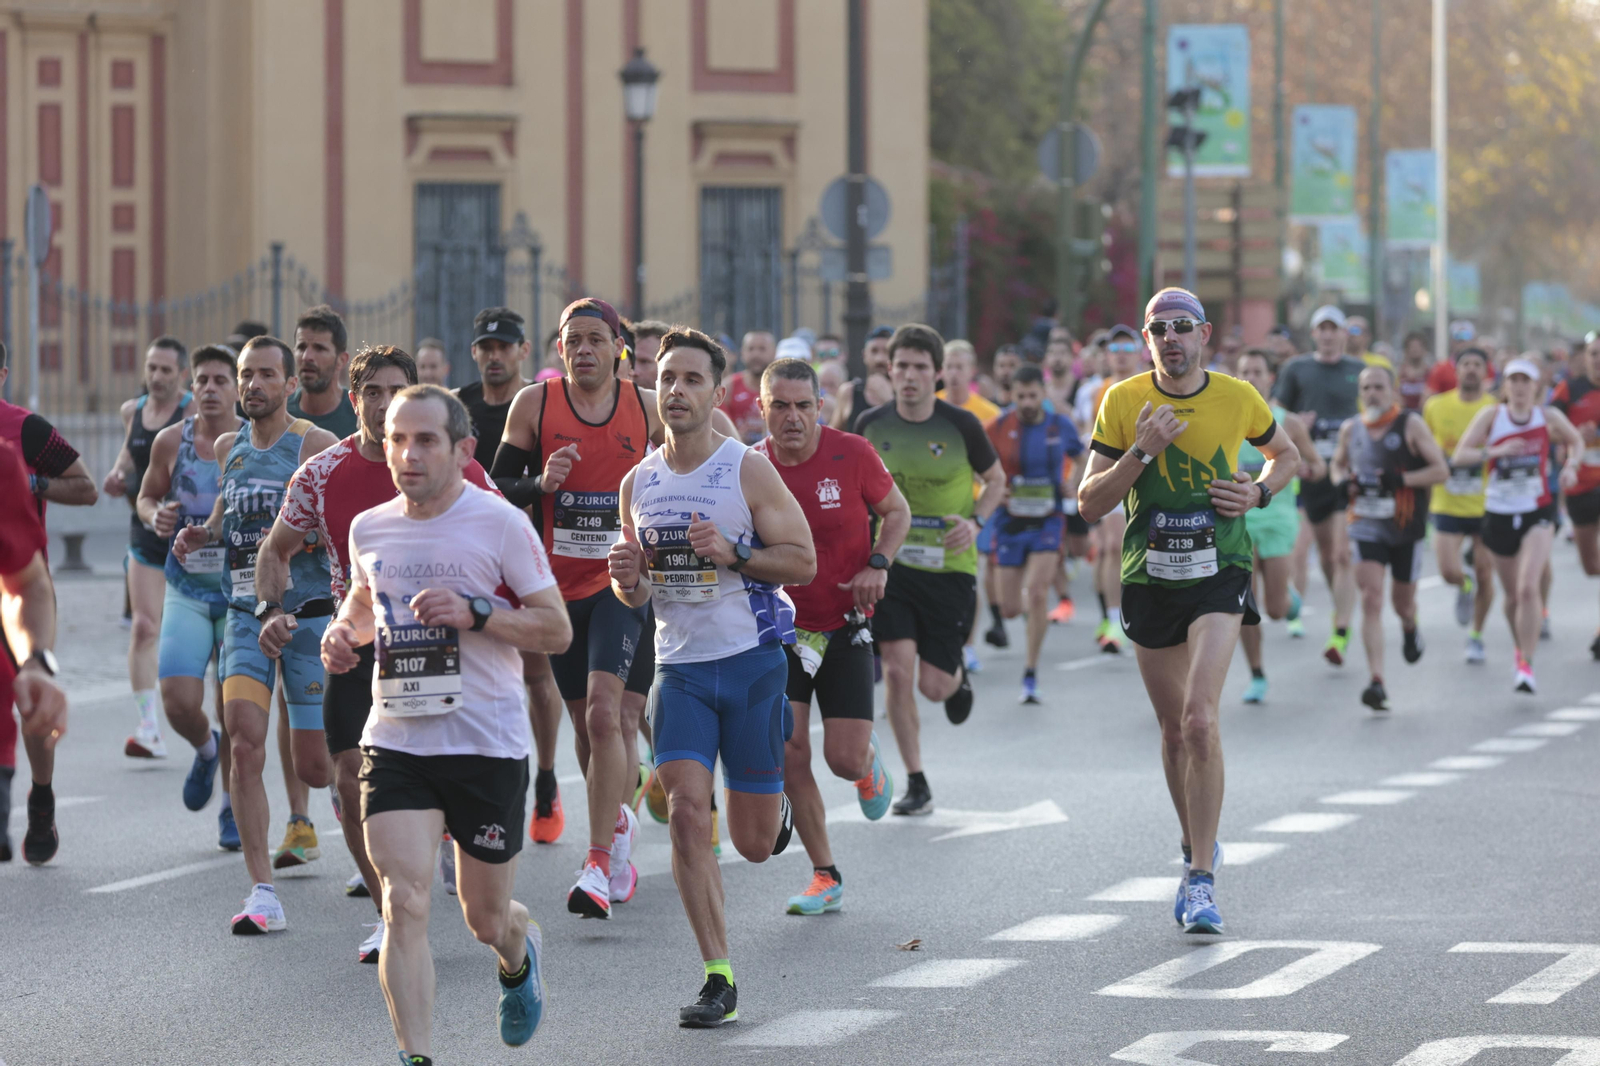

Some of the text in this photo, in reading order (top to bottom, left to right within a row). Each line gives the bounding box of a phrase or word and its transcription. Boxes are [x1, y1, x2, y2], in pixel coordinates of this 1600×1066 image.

[577, 496, 618, 505] ZURICH
[641, 496, 668, 509] TALLERES
[686, 495, 716, 506] GALLEGO
[576, 516, 602, 527] 2149
[1167, 515, 1207, 527] ZURICH
[571, 532, 607, 542] CENTENO
[661, 530, 689, 541] ZURI
[1167, 538, 1194, 549] 2139
[665, 554, 688, 566] 1961
[383, 563, 468, 579] IDIAZABAL
[664, 573, 695, 583] PEDRITO
[393, 628, 446, 642] ZURICH
[395, 657, 427, 673] 3107
[403, 682, 420, 693] AXI
